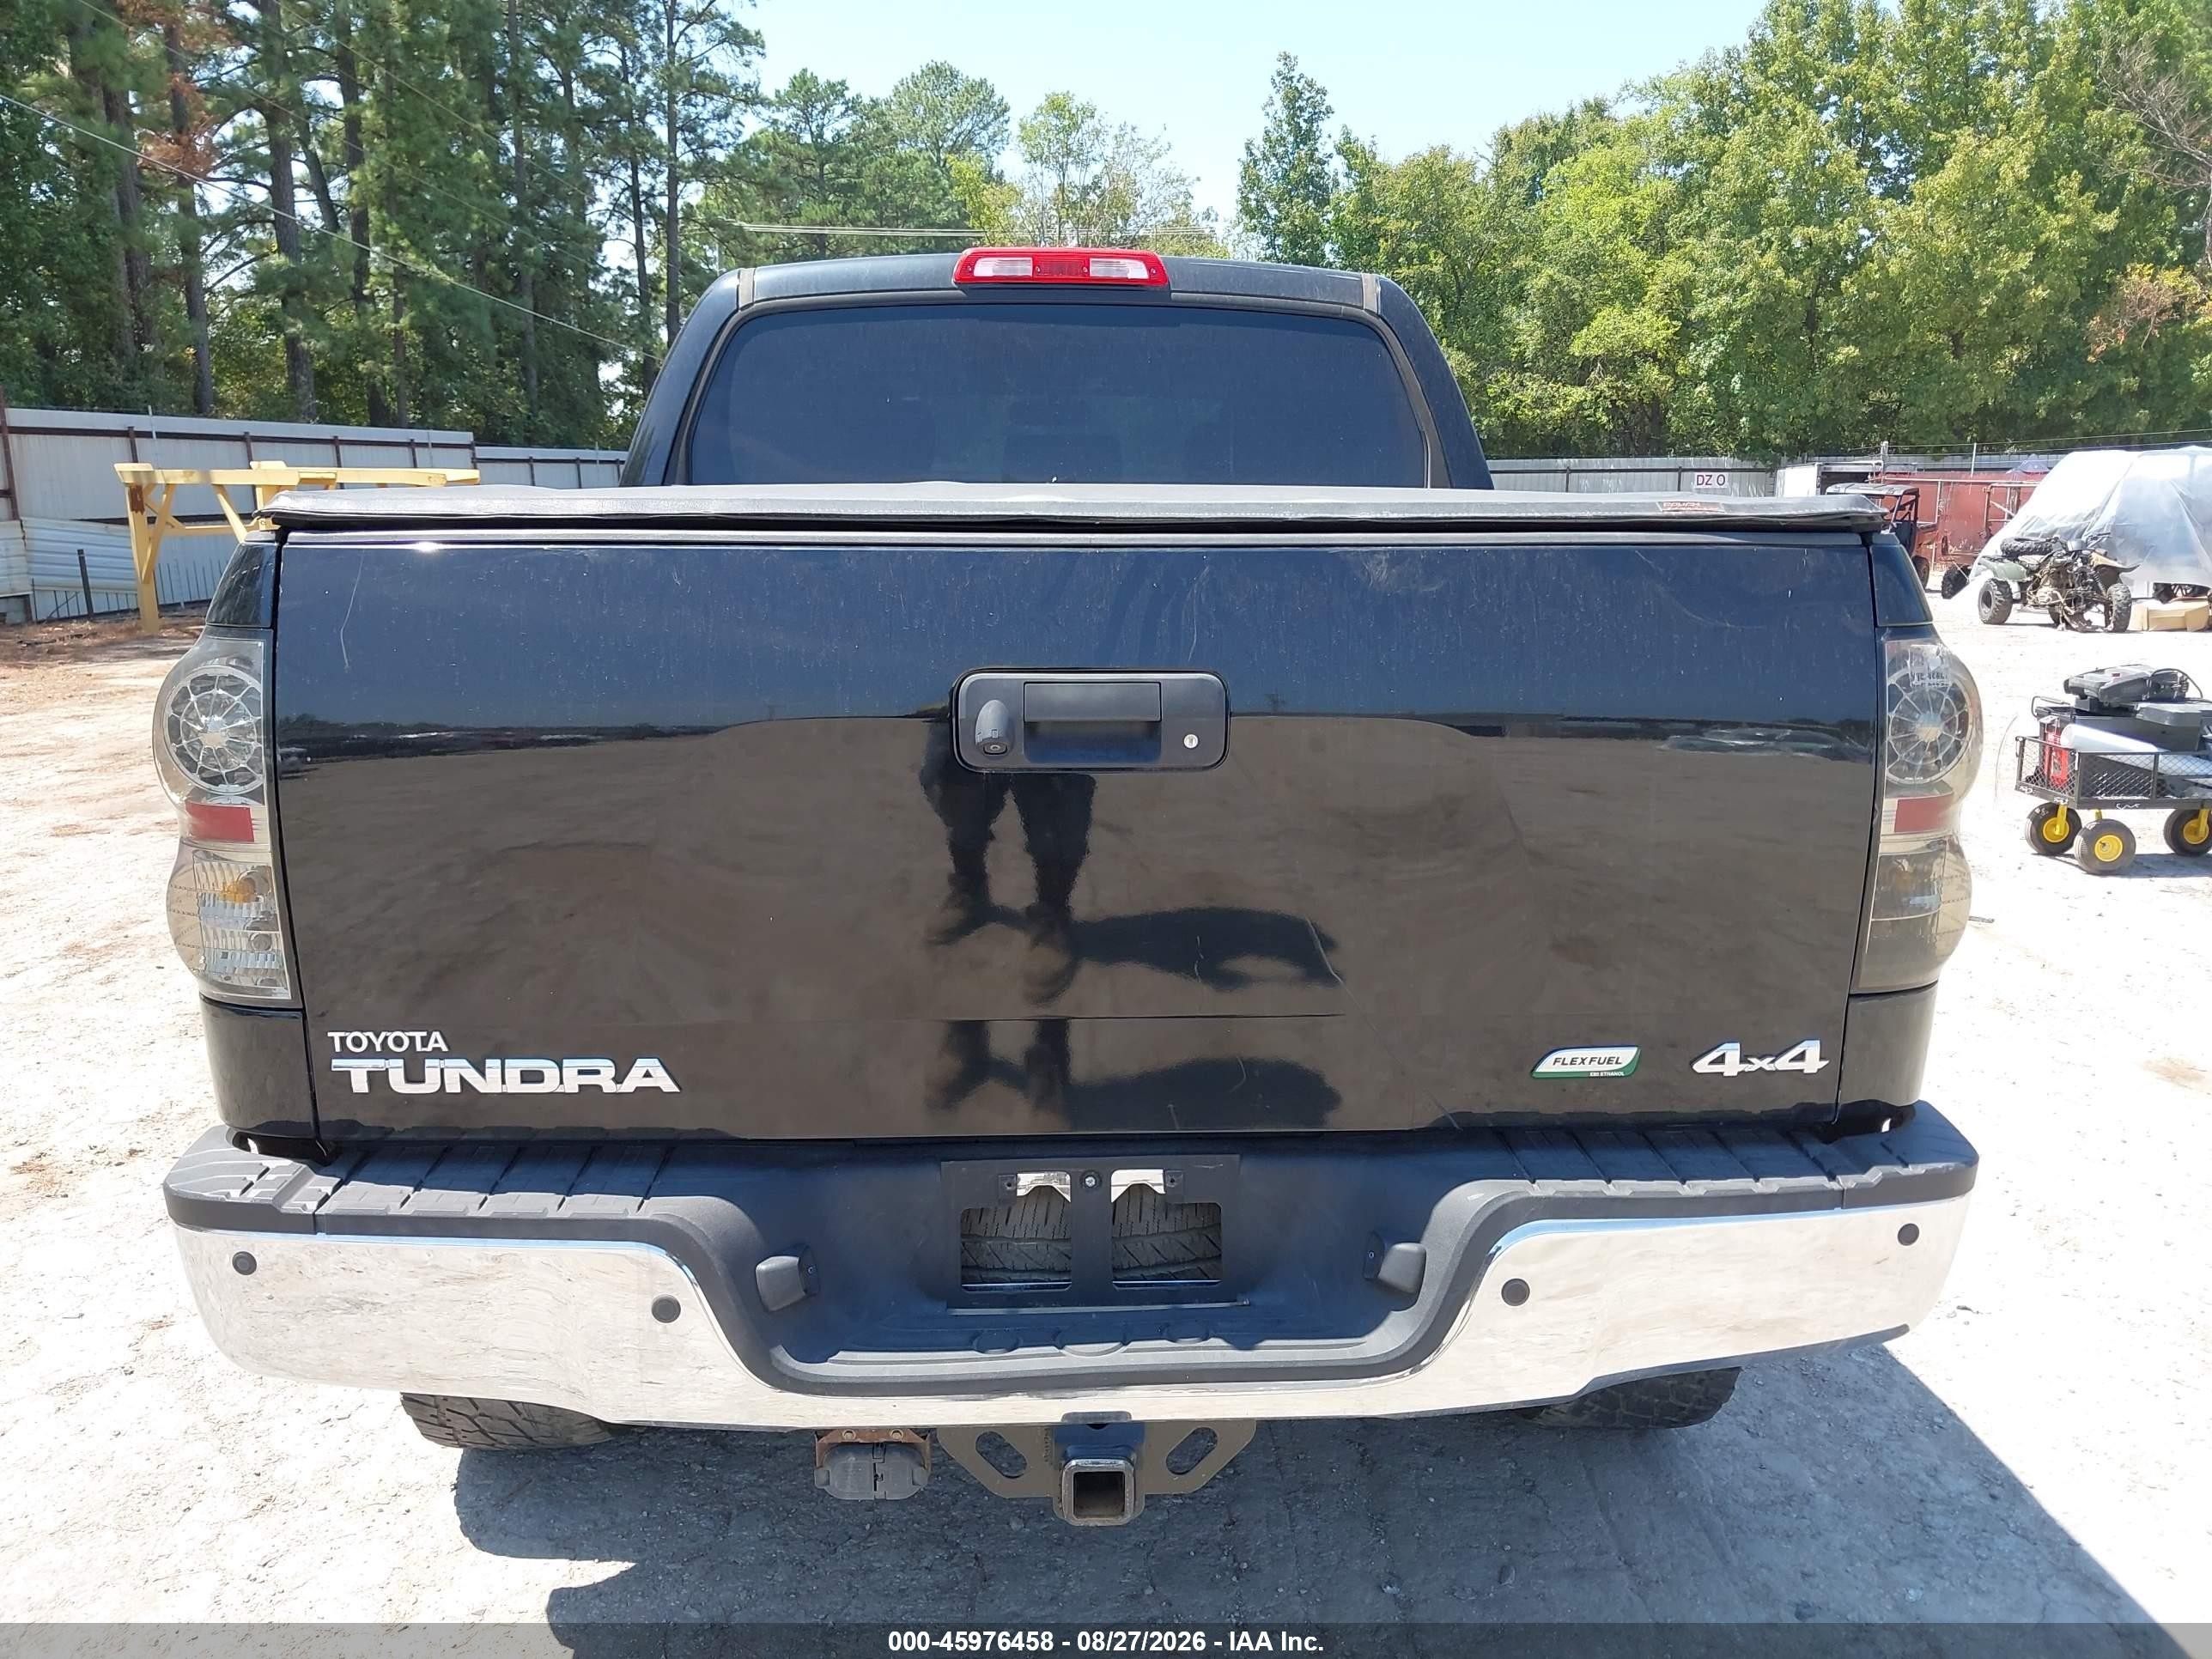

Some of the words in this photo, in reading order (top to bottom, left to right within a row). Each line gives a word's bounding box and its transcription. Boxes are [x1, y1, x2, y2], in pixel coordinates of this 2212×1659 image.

[1697, 474, 1712, 485] DZ
[327, 1030, 448, 1053] TOYOTA
[1692, 1039, 1830, 1077] 4x4
[331, 1058, 681, 1094] TUNDRA
